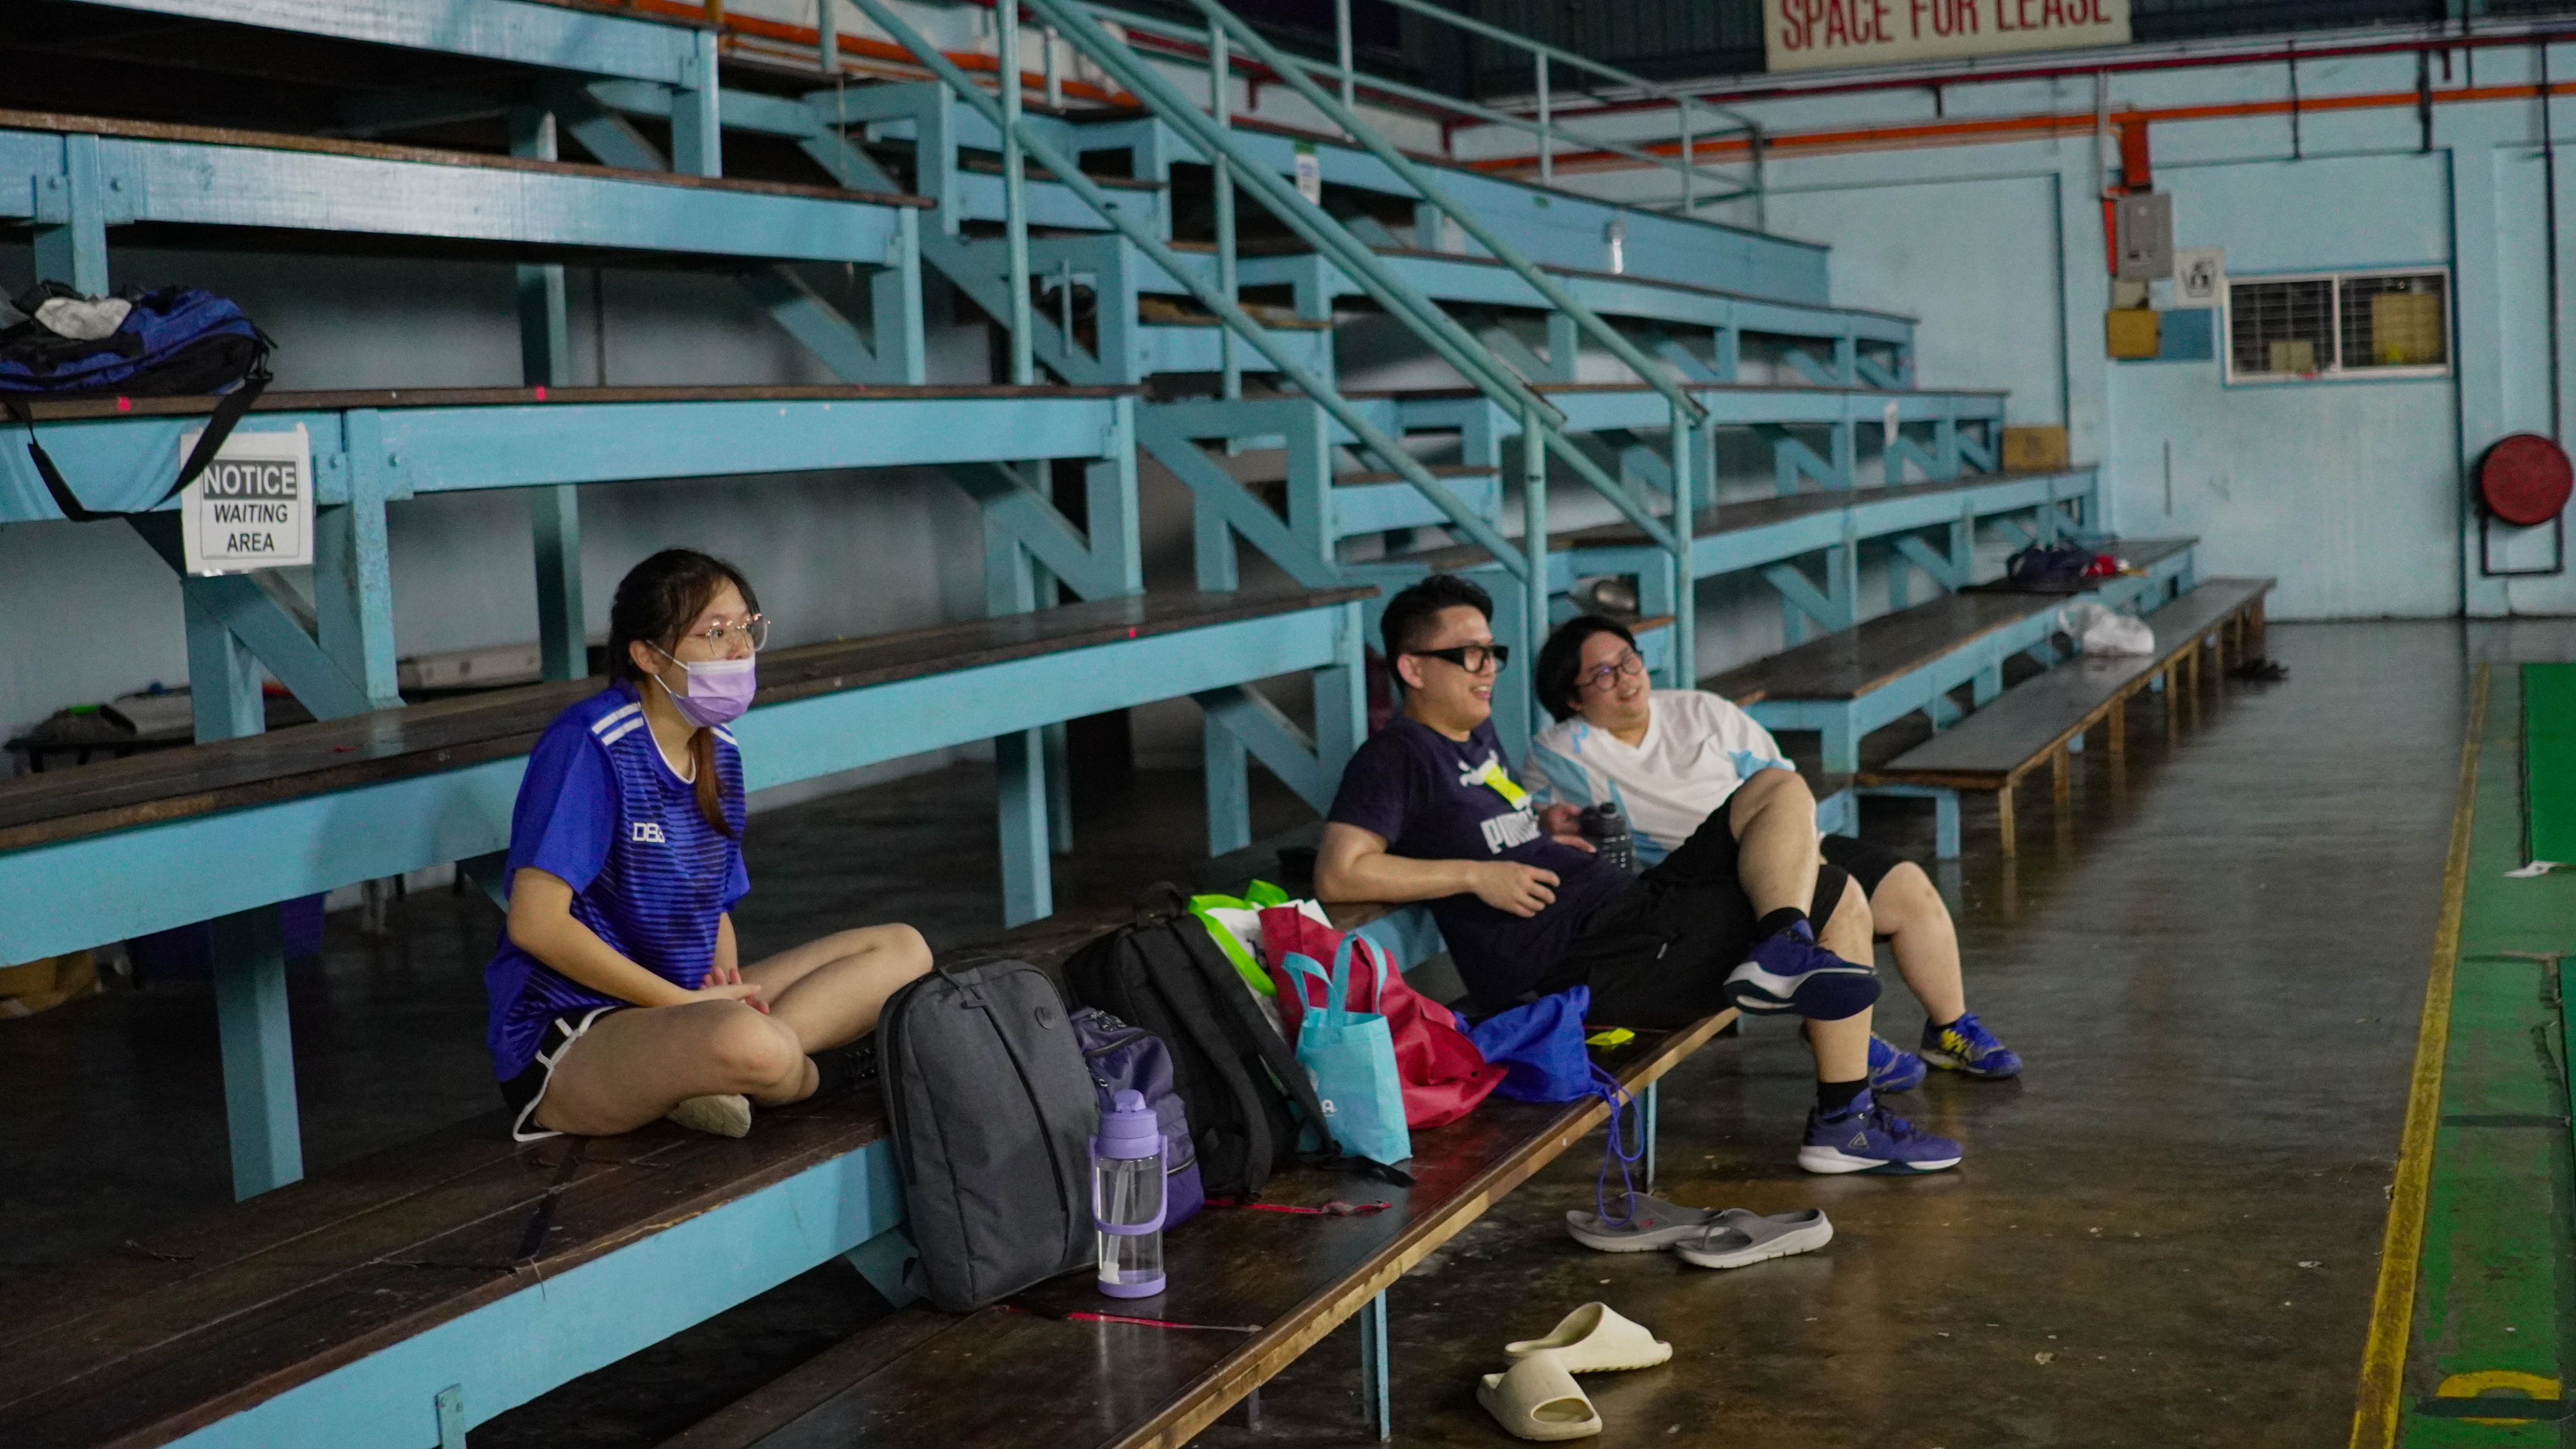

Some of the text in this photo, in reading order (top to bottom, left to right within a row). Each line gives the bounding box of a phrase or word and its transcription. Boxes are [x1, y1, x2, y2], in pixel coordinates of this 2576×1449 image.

[1781, 0, 1894, 51] SPACE
[203, 465, 297, 494] NOTICE
[215, 504, 288, 524] WAITING
[227, 533, 275, 552] AREA
